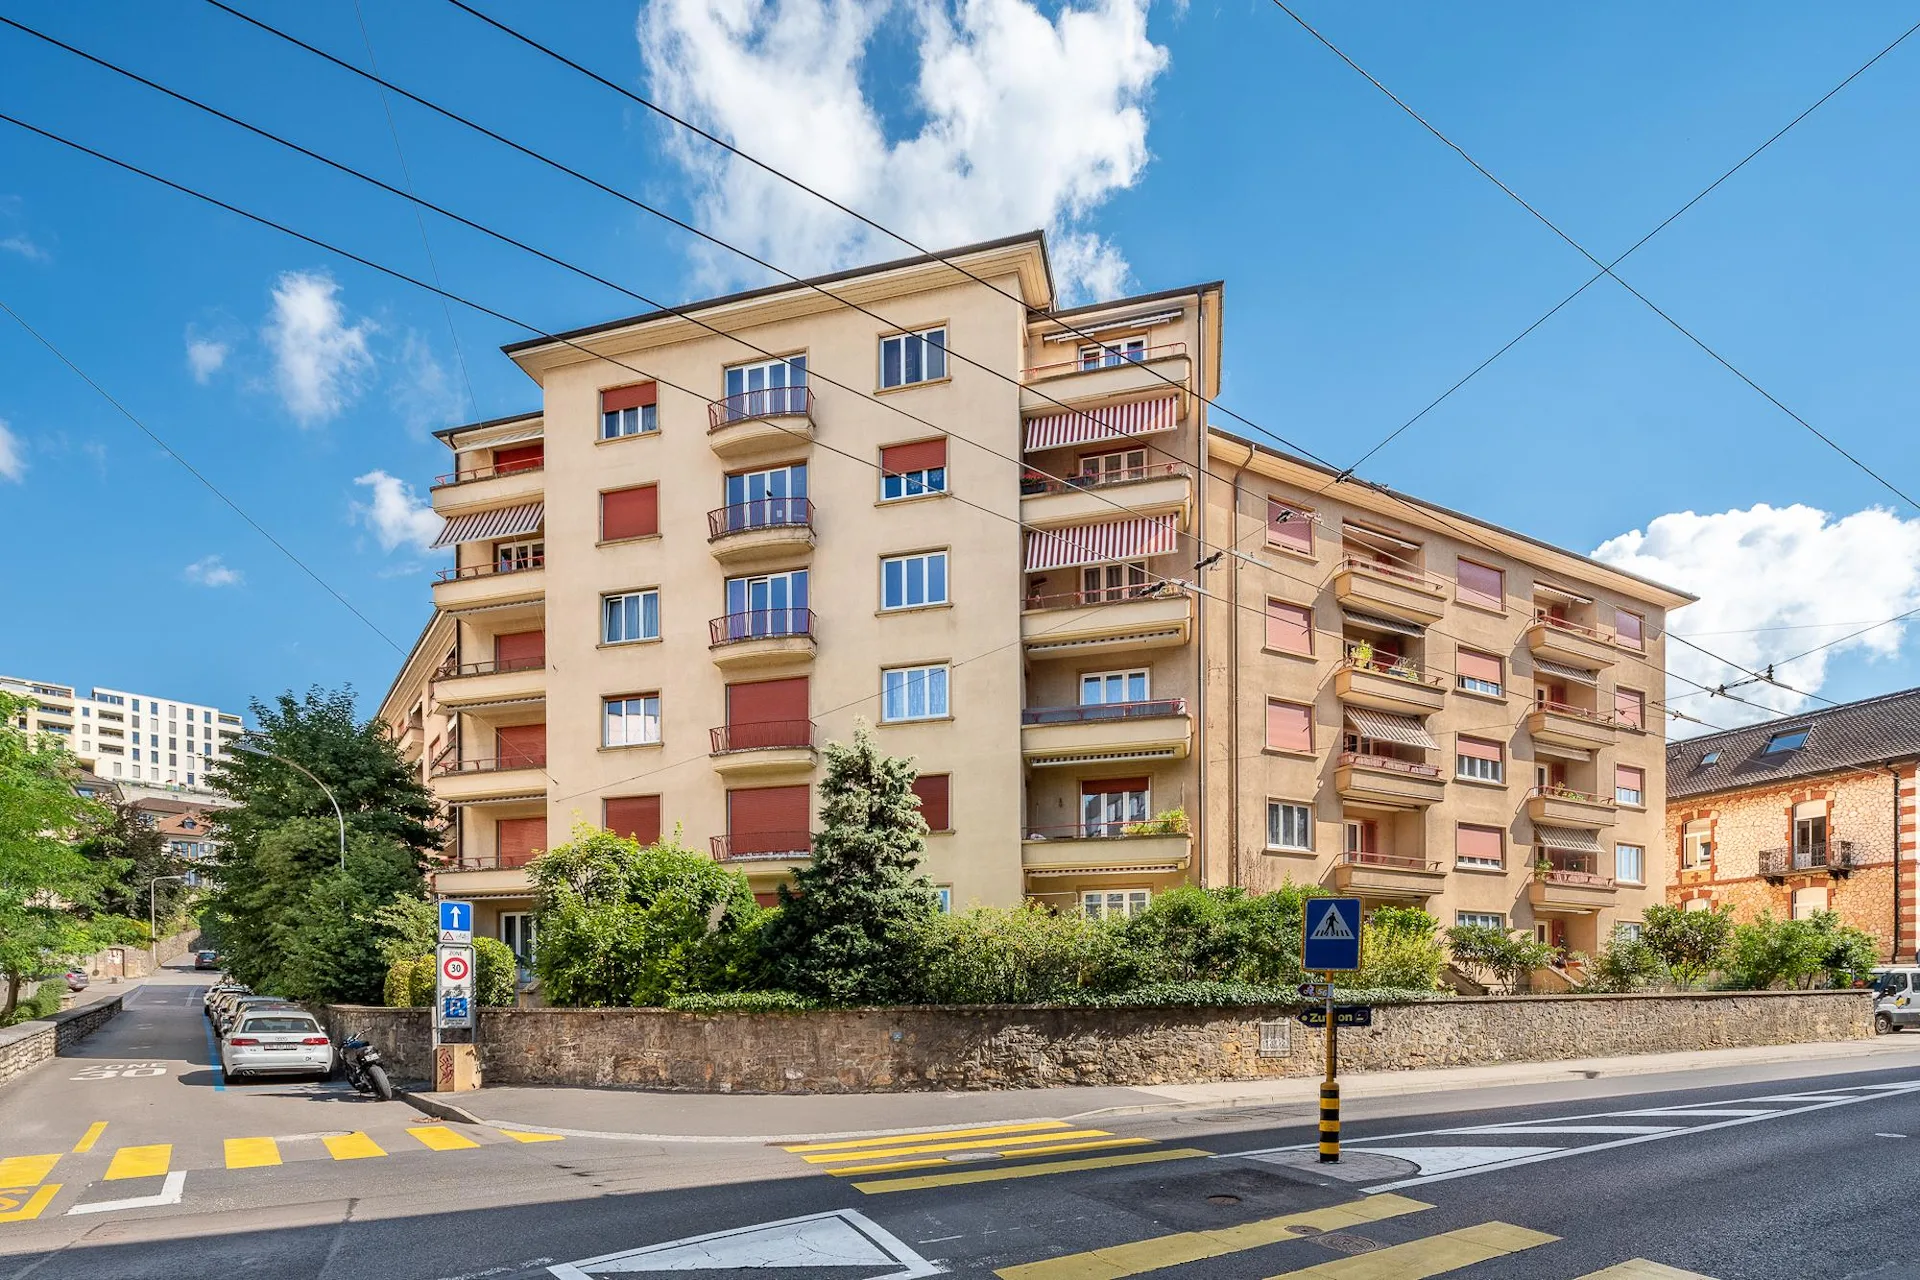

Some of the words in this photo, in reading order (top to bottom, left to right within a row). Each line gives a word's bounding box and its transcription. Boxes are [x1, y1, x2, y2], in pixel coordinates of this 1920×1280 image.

[451, 964, 461, 973] 30
[79, 1062, 168, 1072] ZONE
[69, 1068, 167, 1081] 30
